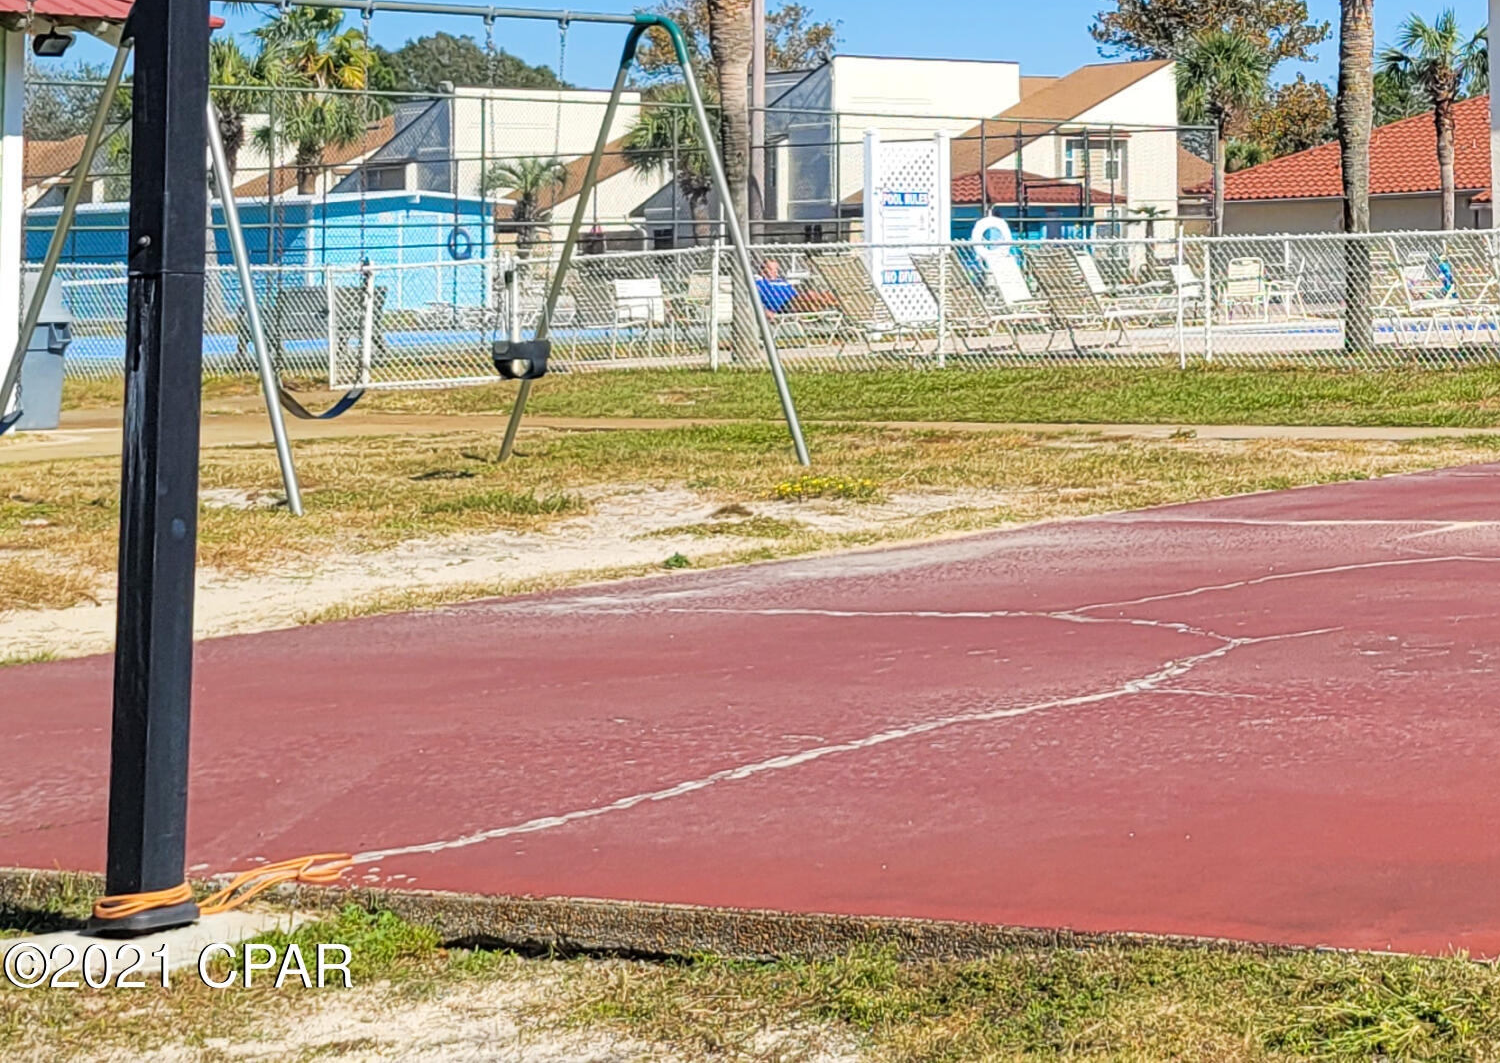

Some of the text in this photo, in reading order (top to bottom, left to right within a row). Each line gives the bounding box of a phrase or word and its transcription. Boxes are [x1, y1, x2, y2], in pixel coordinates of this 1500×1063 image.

[882, 193, 929, 205] POOL RULES
[884, 270, 897, 283] NO
